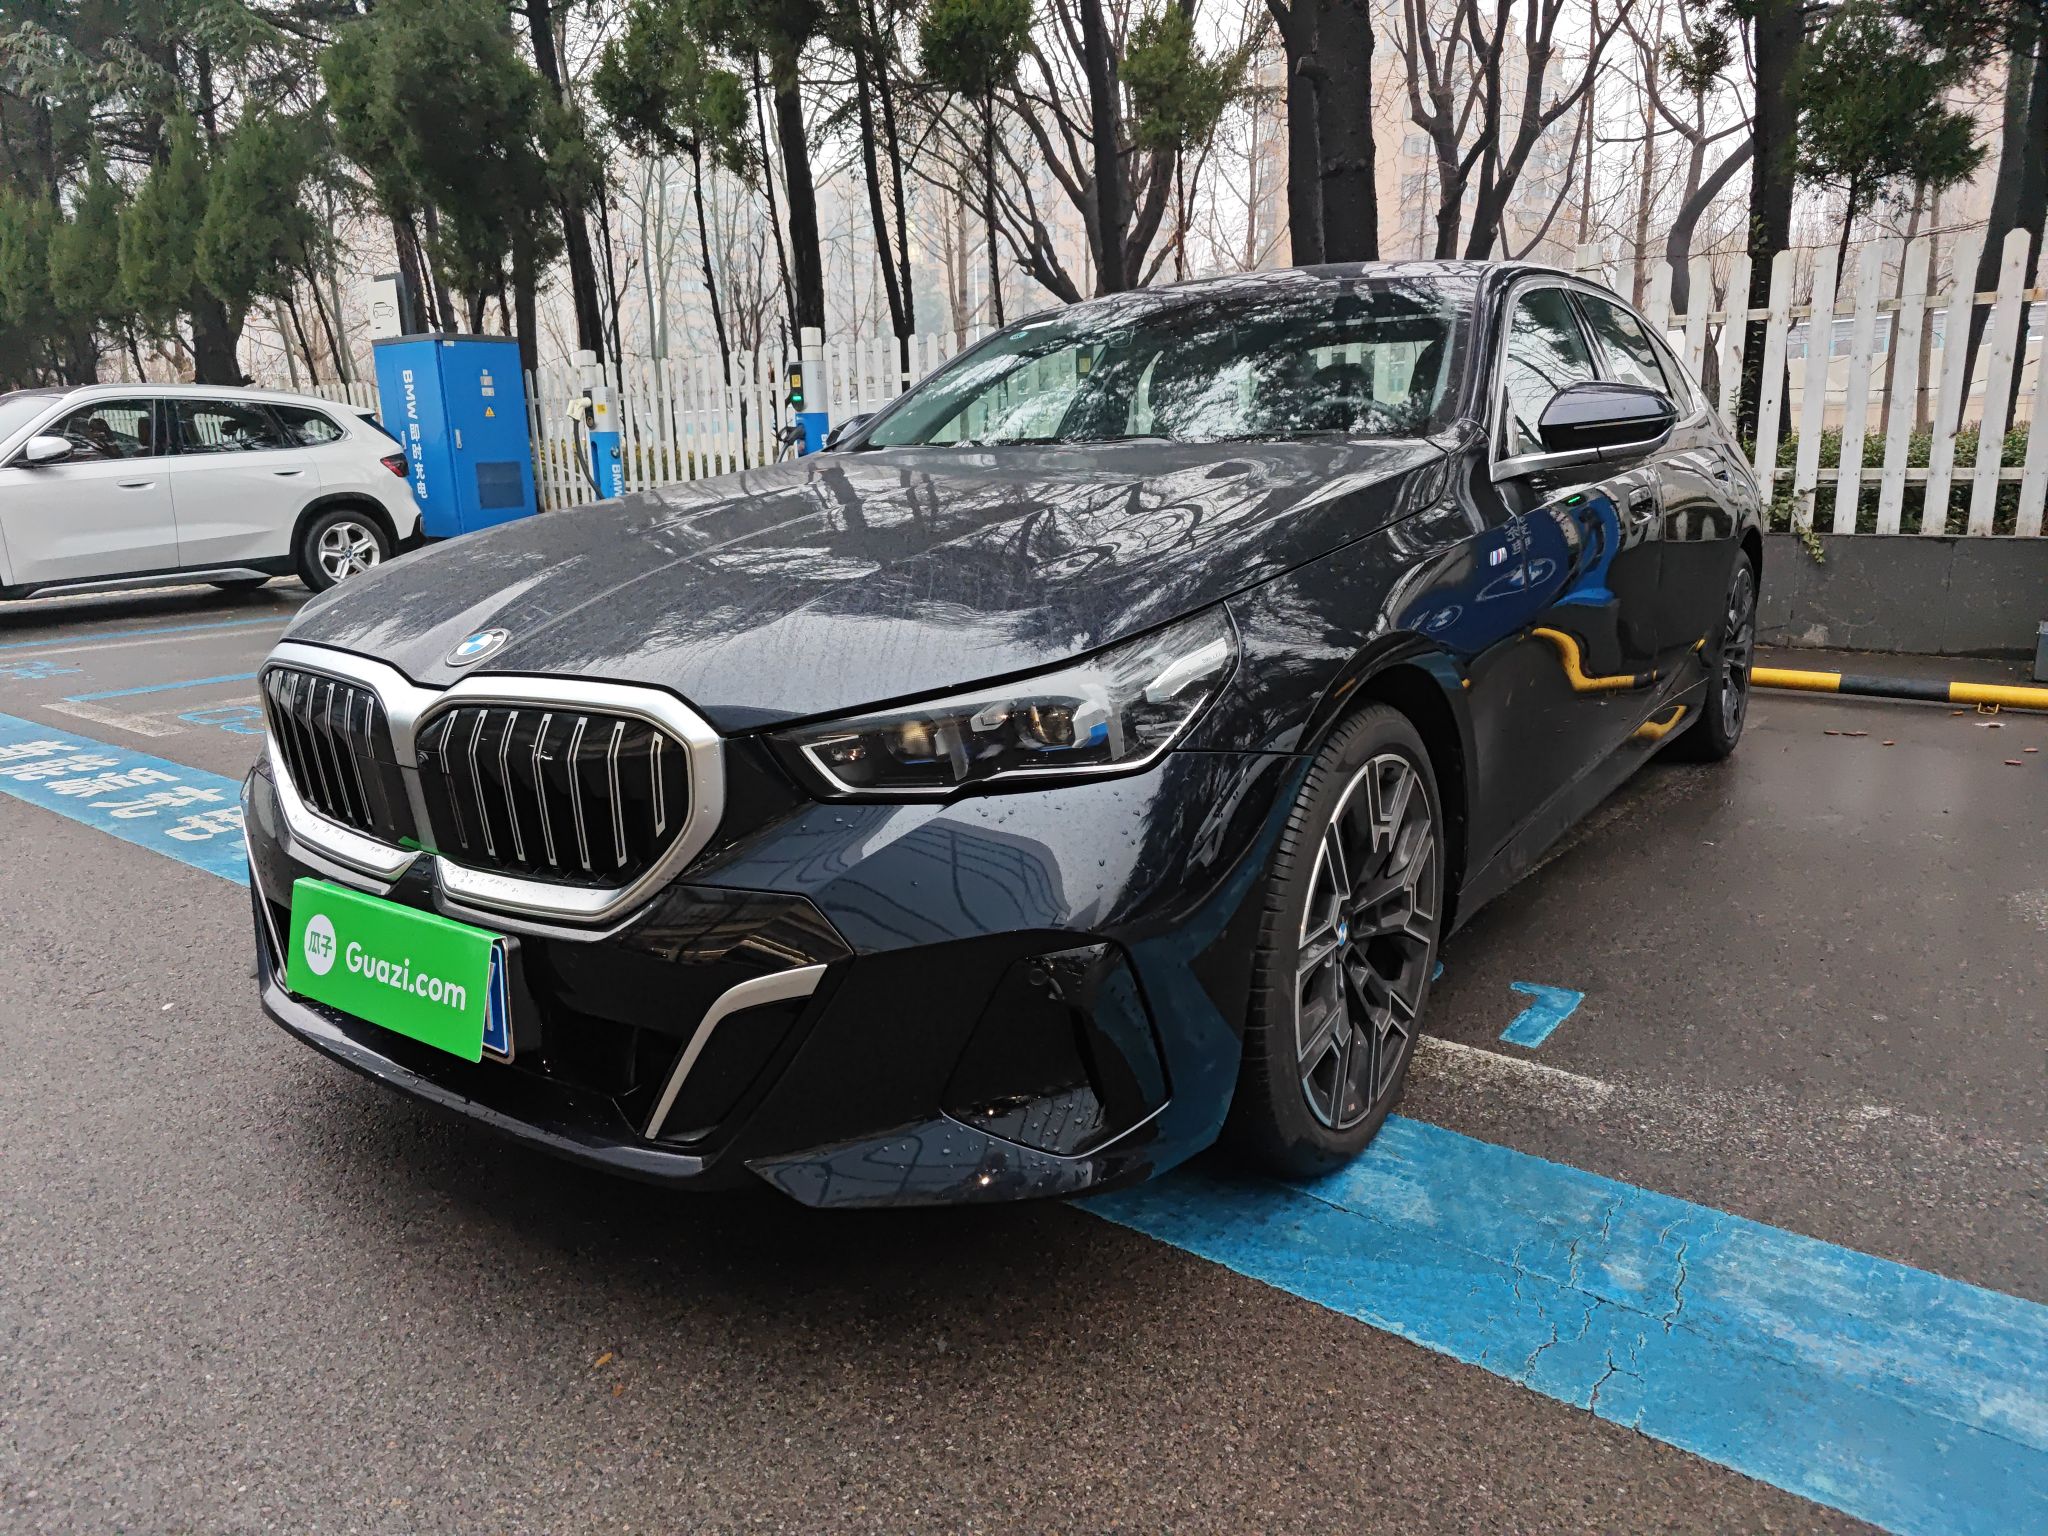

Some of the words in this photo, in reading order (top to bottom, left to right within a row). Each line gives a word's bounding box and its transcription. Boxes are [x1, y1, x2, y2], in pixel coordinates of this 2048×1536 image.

[402, 369, 418, 420] BMW
[308, 930, 333, 958] 瓜子
[345, 941, 467, 1011] Guazi.com
